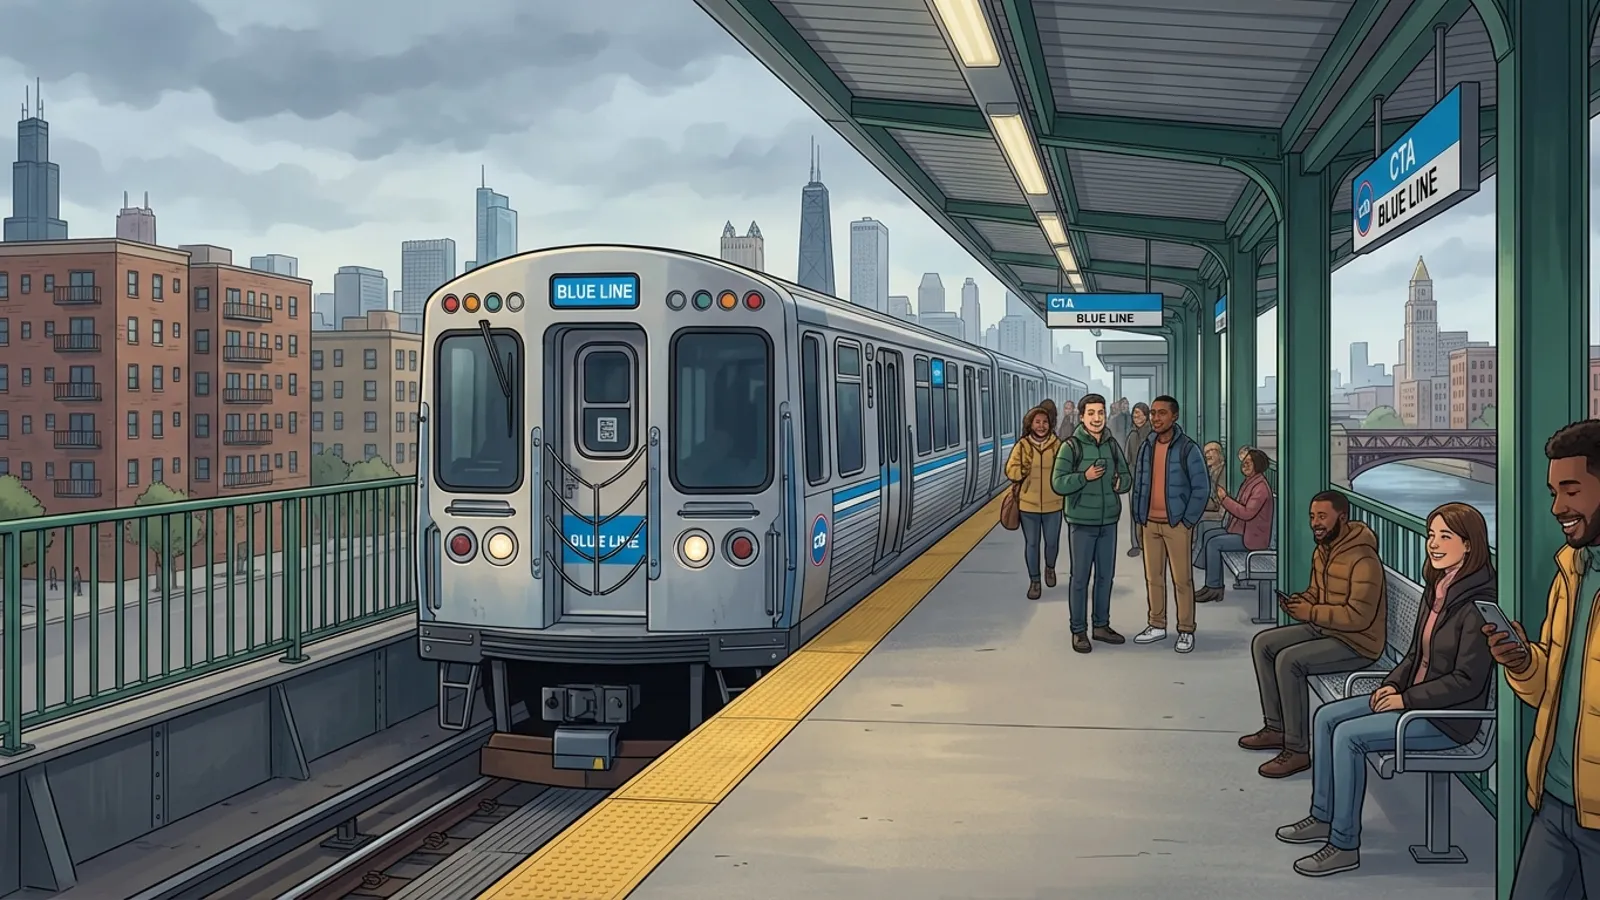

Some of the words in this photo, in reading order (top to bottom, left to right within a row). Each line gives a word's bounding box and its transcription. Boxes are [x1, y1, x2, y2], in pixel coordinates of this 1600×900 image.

[1389, 137, 1416, 181] CTA
[1378, 188, 1406, 228] BLUE
[1409, 166, 1438, 209] LINE
[557, 284, 596, 299] BLUE
[600, 283, 633, 299] LINE
[1051, 298, 1074, 308] CTA
[1076, 313, 1106, 323] BLUE
[1109, 313, 1135, 323] LINE
